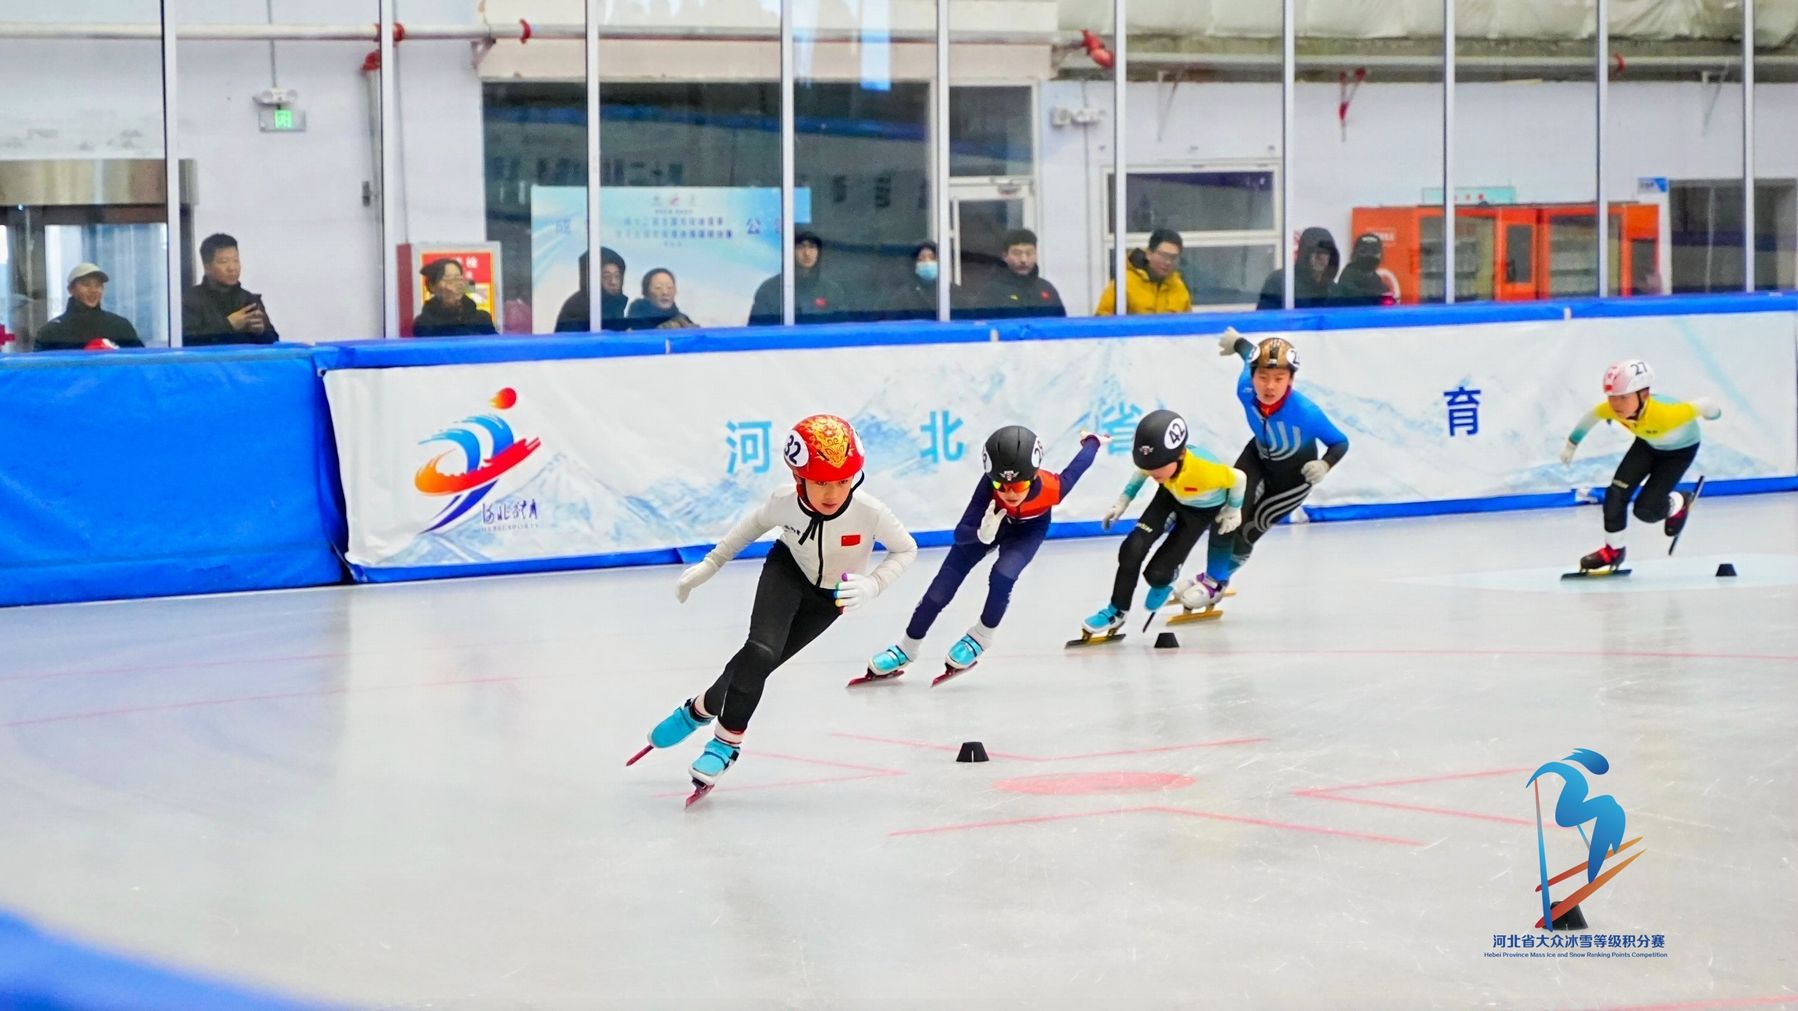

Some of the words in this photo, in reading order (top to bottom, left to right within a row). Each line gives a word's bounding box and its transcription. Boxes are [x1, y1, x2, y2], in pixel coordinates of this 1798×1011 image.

[1630, 361, 1648, 376] 27
[726, 420, 772, 475] 河
[919, 410, 966, 465] 北
[1443, 386, 1481, 437] 育
[1168, 422, 1186, 445] 42
[784, 434, 802, 465] 32
